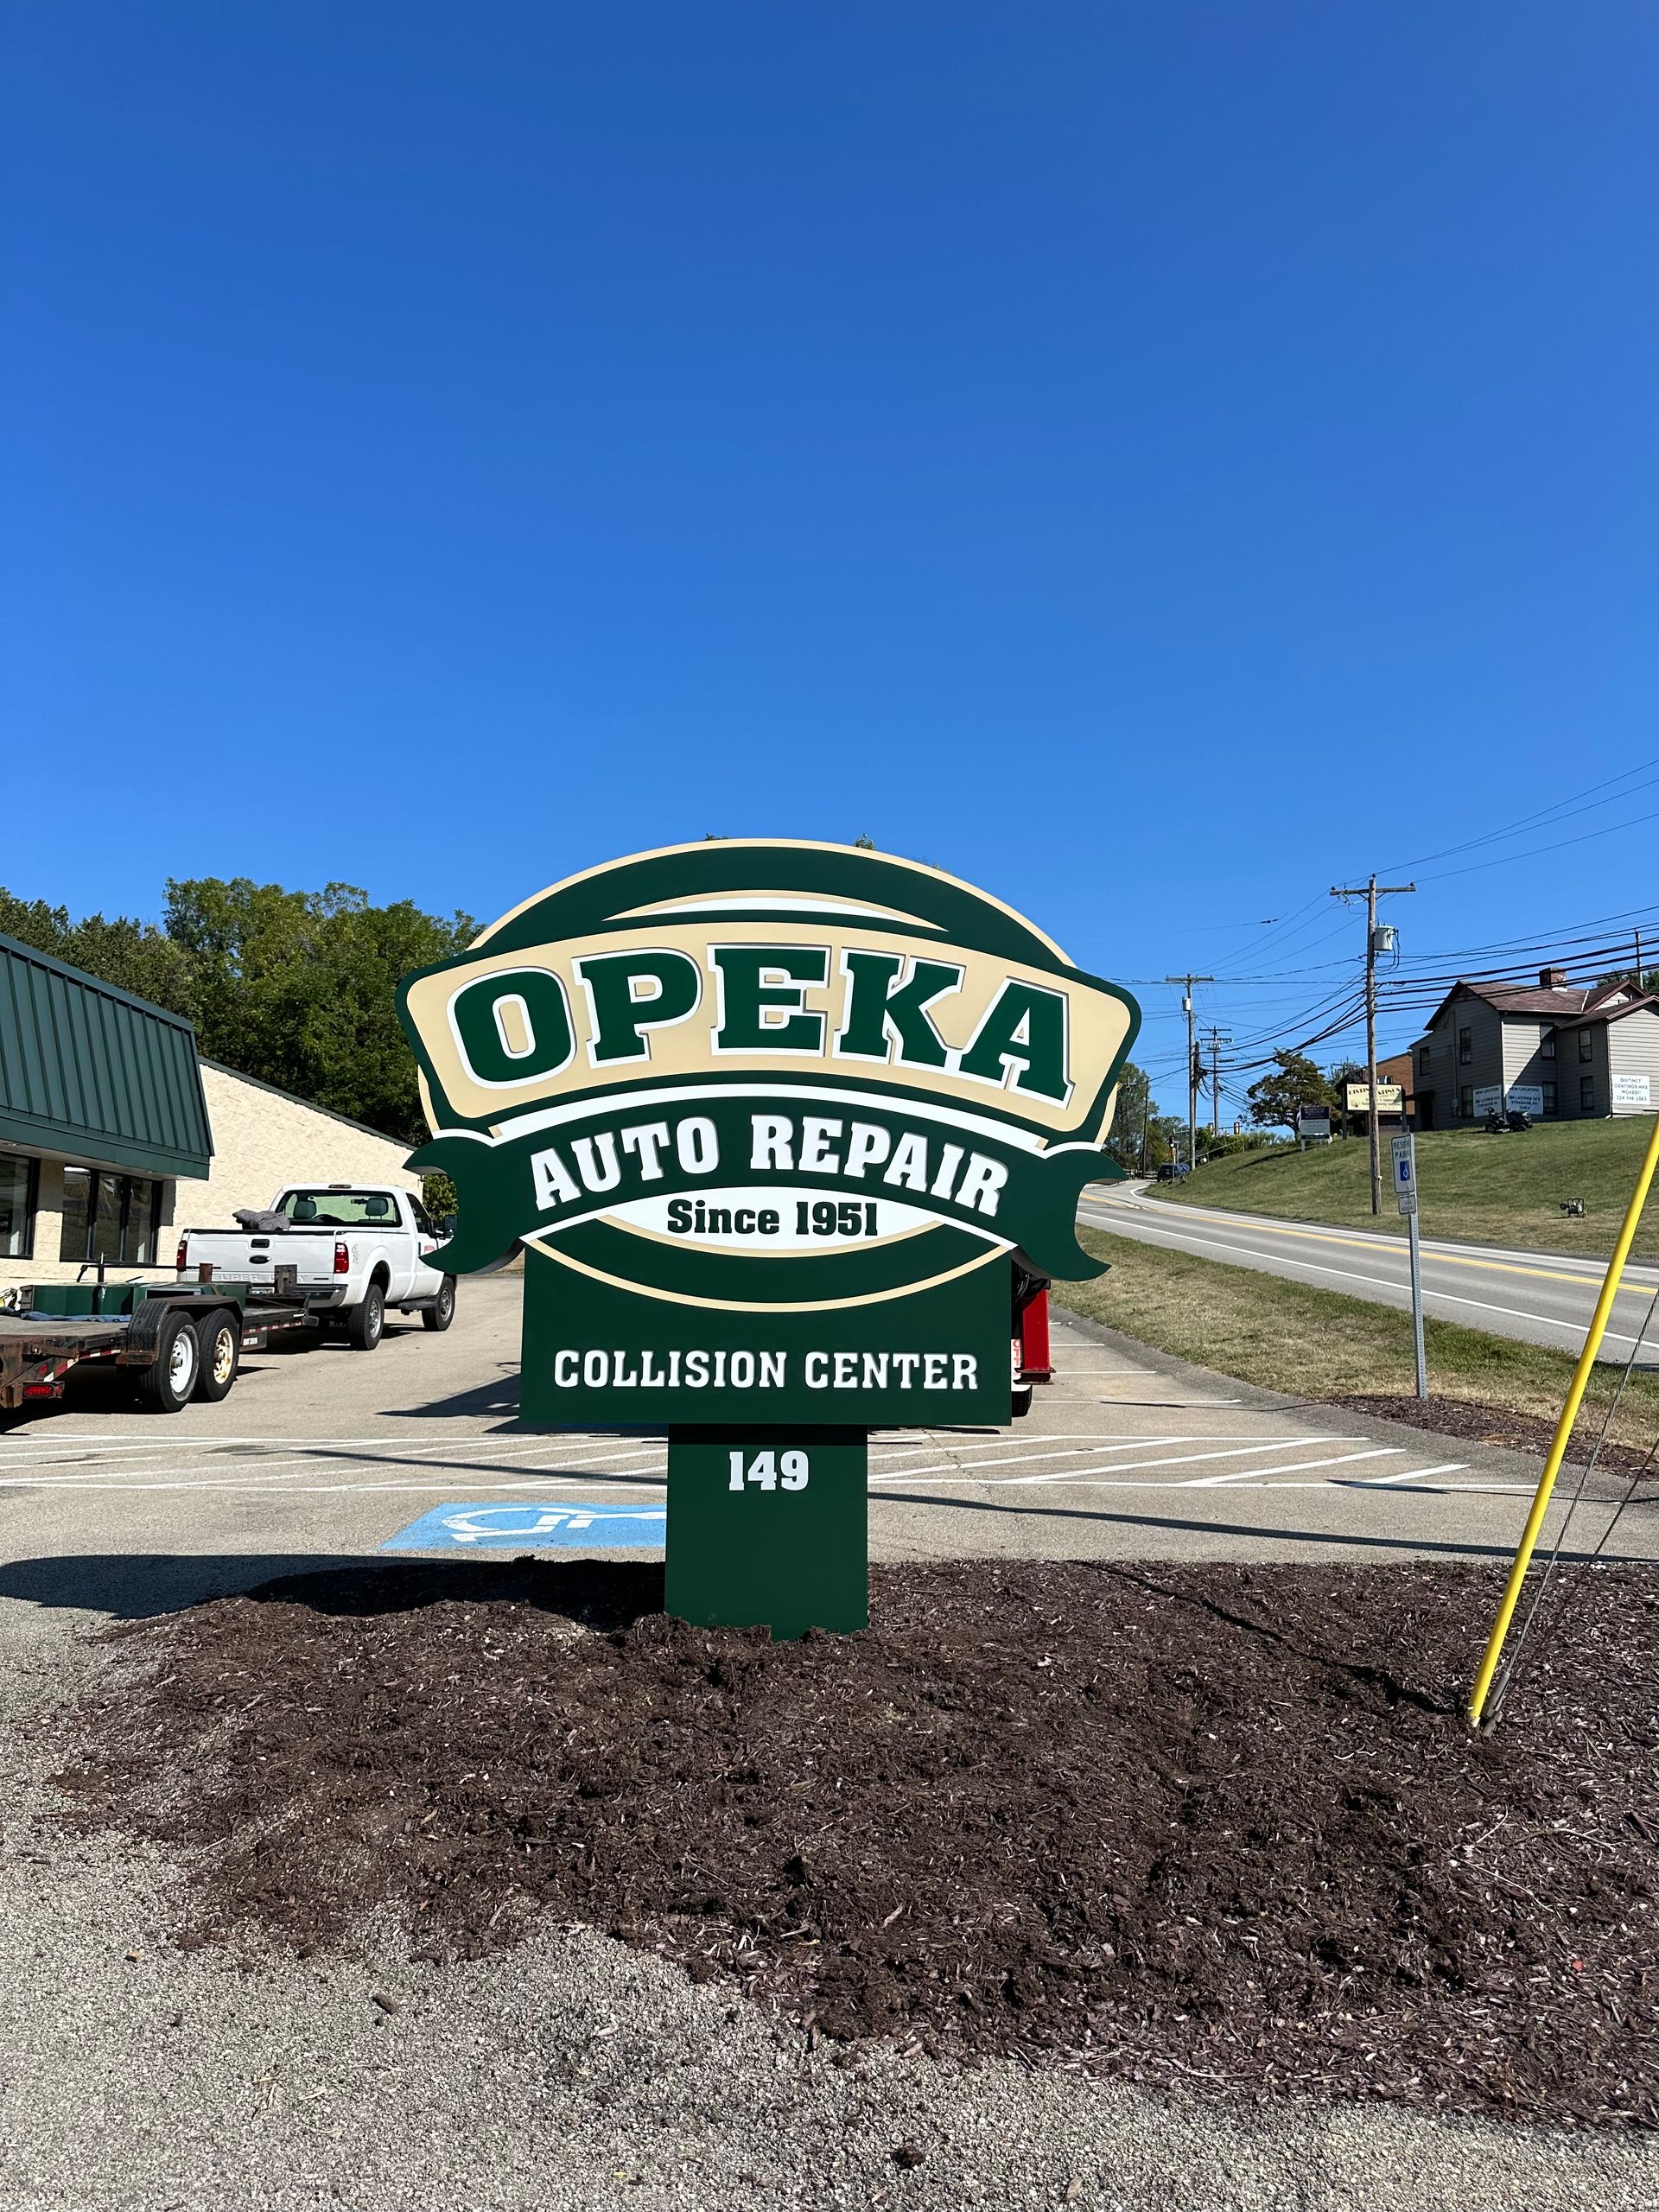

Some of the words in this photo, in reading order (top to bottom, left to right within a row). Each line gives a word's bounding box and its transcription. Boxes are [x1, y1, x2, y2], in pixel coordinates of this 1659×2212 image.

[447, 944, 1074, 1109] OPEKA
[530, 1116, 719, 1211] AUTO
[750, 1114, 1008, 1217] REPAIR
[666, 1198, 779, 1236] Since
[796, 1201, 878, 1236] 1951
[213, 1273, 260, 1283] SUPER
[554, 1349, 787, 1389] COLLISION
[804, 1351, 979, 1391] CENTER
[728, 1450, 810, 1492] 149
